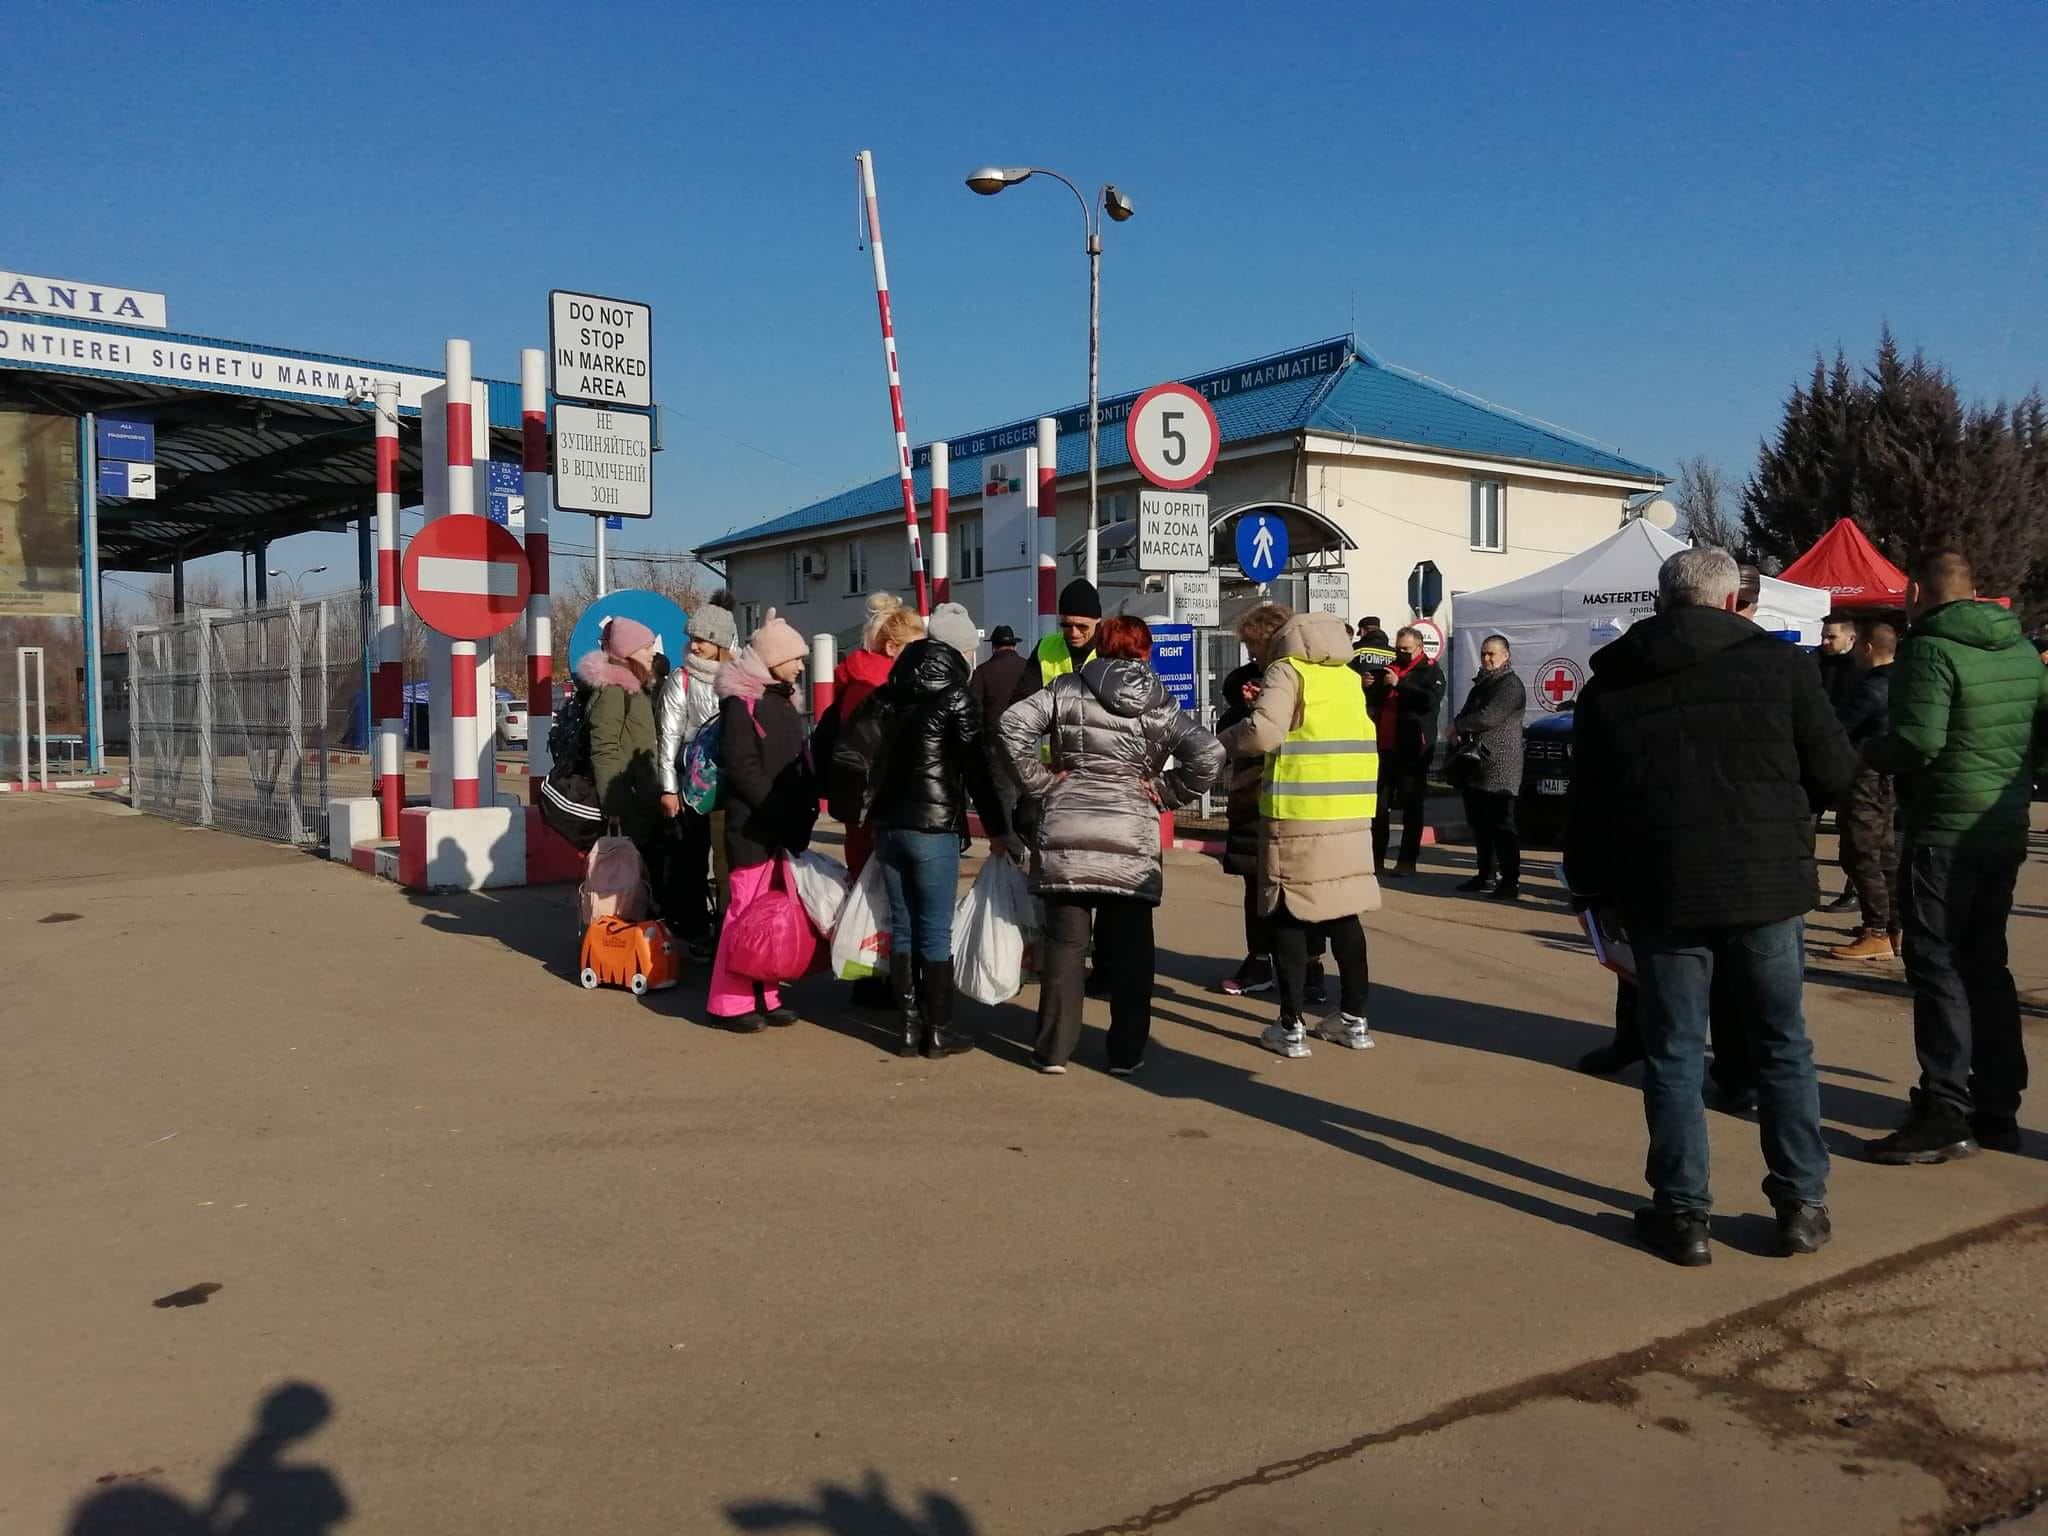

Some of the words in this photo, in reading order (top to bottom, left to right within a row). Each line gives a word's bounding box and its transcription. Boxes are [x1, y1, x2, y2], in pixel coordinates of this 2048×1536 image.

[569, 302, 594, 322] DO
[600, 306, 634, 328] NOT
[580, 328, 624, 350] STOP
[153, 349, 263, 379] SIGHETU
[558, 348, 574, 367] IN
[580, 352, 646, 377] MARKED
[580, 376, 626, 398] AREA
[972, 438, 986, 453] DE
[1241, 351, 1334, 389] MARMATIEI
[596, 412, 613, 430] НЕ
[560, 432, 647, 457] ЗУПИНЯЙТЕСЬ
[1162, 411, 1186, 466] 5
[561, 457, 569, 475] В
[574, 459, 646, 482] ВІДМІЧЕНІЙ
[591, 485, 619, 505] ЗОНІ
[1142, 500, 1160, 515] NU
[1164, 501, 1205, 518] OPRITI
[1147, 520, 1160, 535] IN
[1164, 521, 1199, 537] ZONA
[1142, 540, 1204, 557] MARCATA
[1159, 646, 1184, 657] RIGHT
